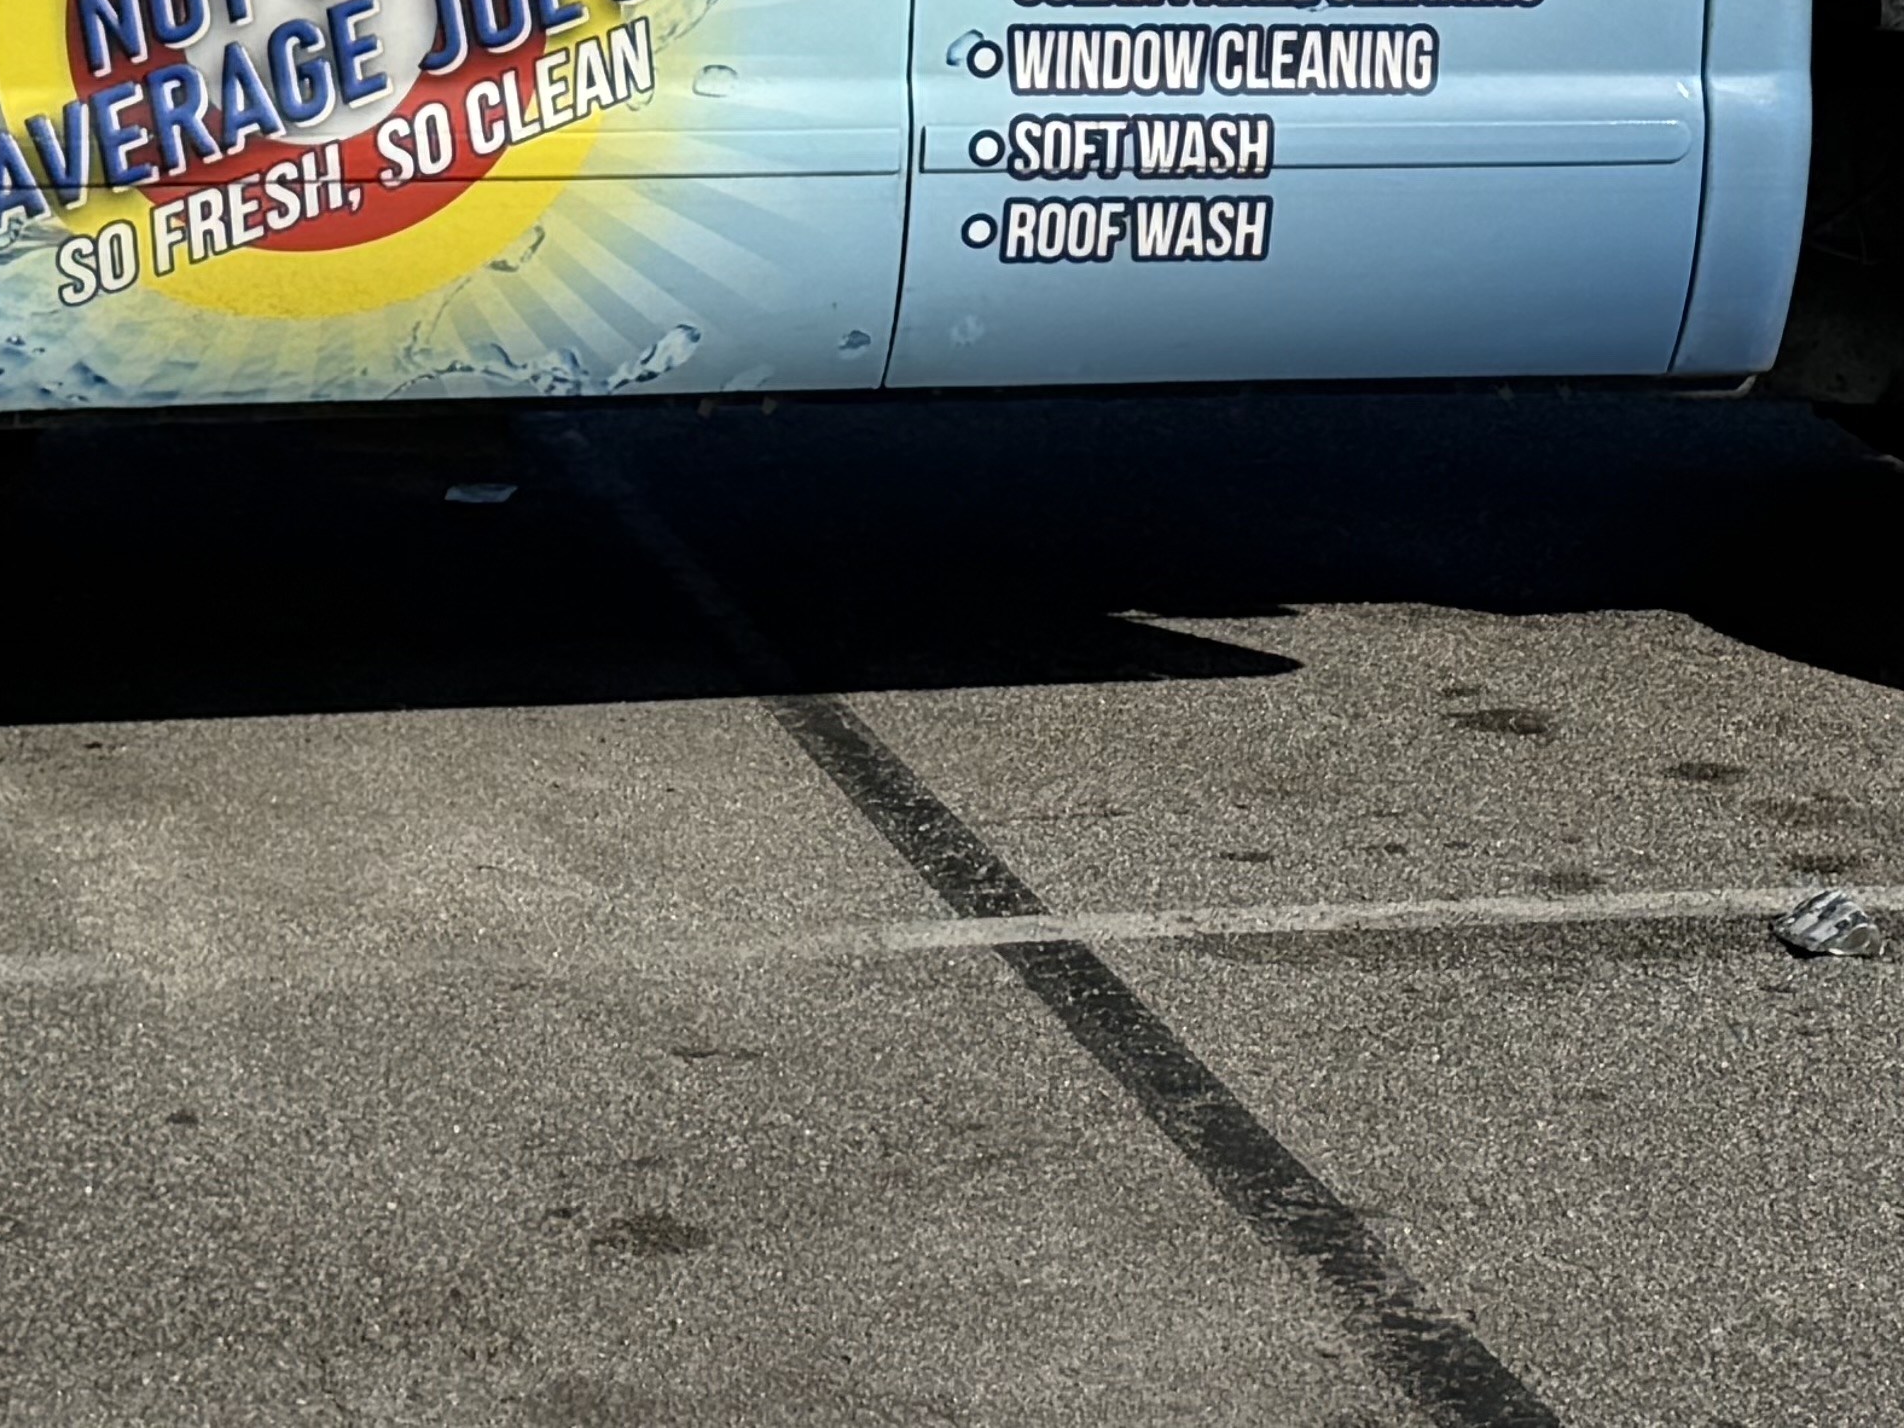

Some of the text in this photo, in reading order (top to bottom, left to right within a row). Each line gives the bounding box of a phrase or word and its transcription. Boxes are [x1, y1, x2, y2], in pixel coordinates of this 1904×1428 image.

[1013, 30, 1434, 90] WINDOW CLEANING
[56, 18, 657, 307] SO FRESH, SO CLEAN
[1013, 120, 1269, 174] SOFT WASH
[1004, 201, 1267, 259] ROOF WASH
